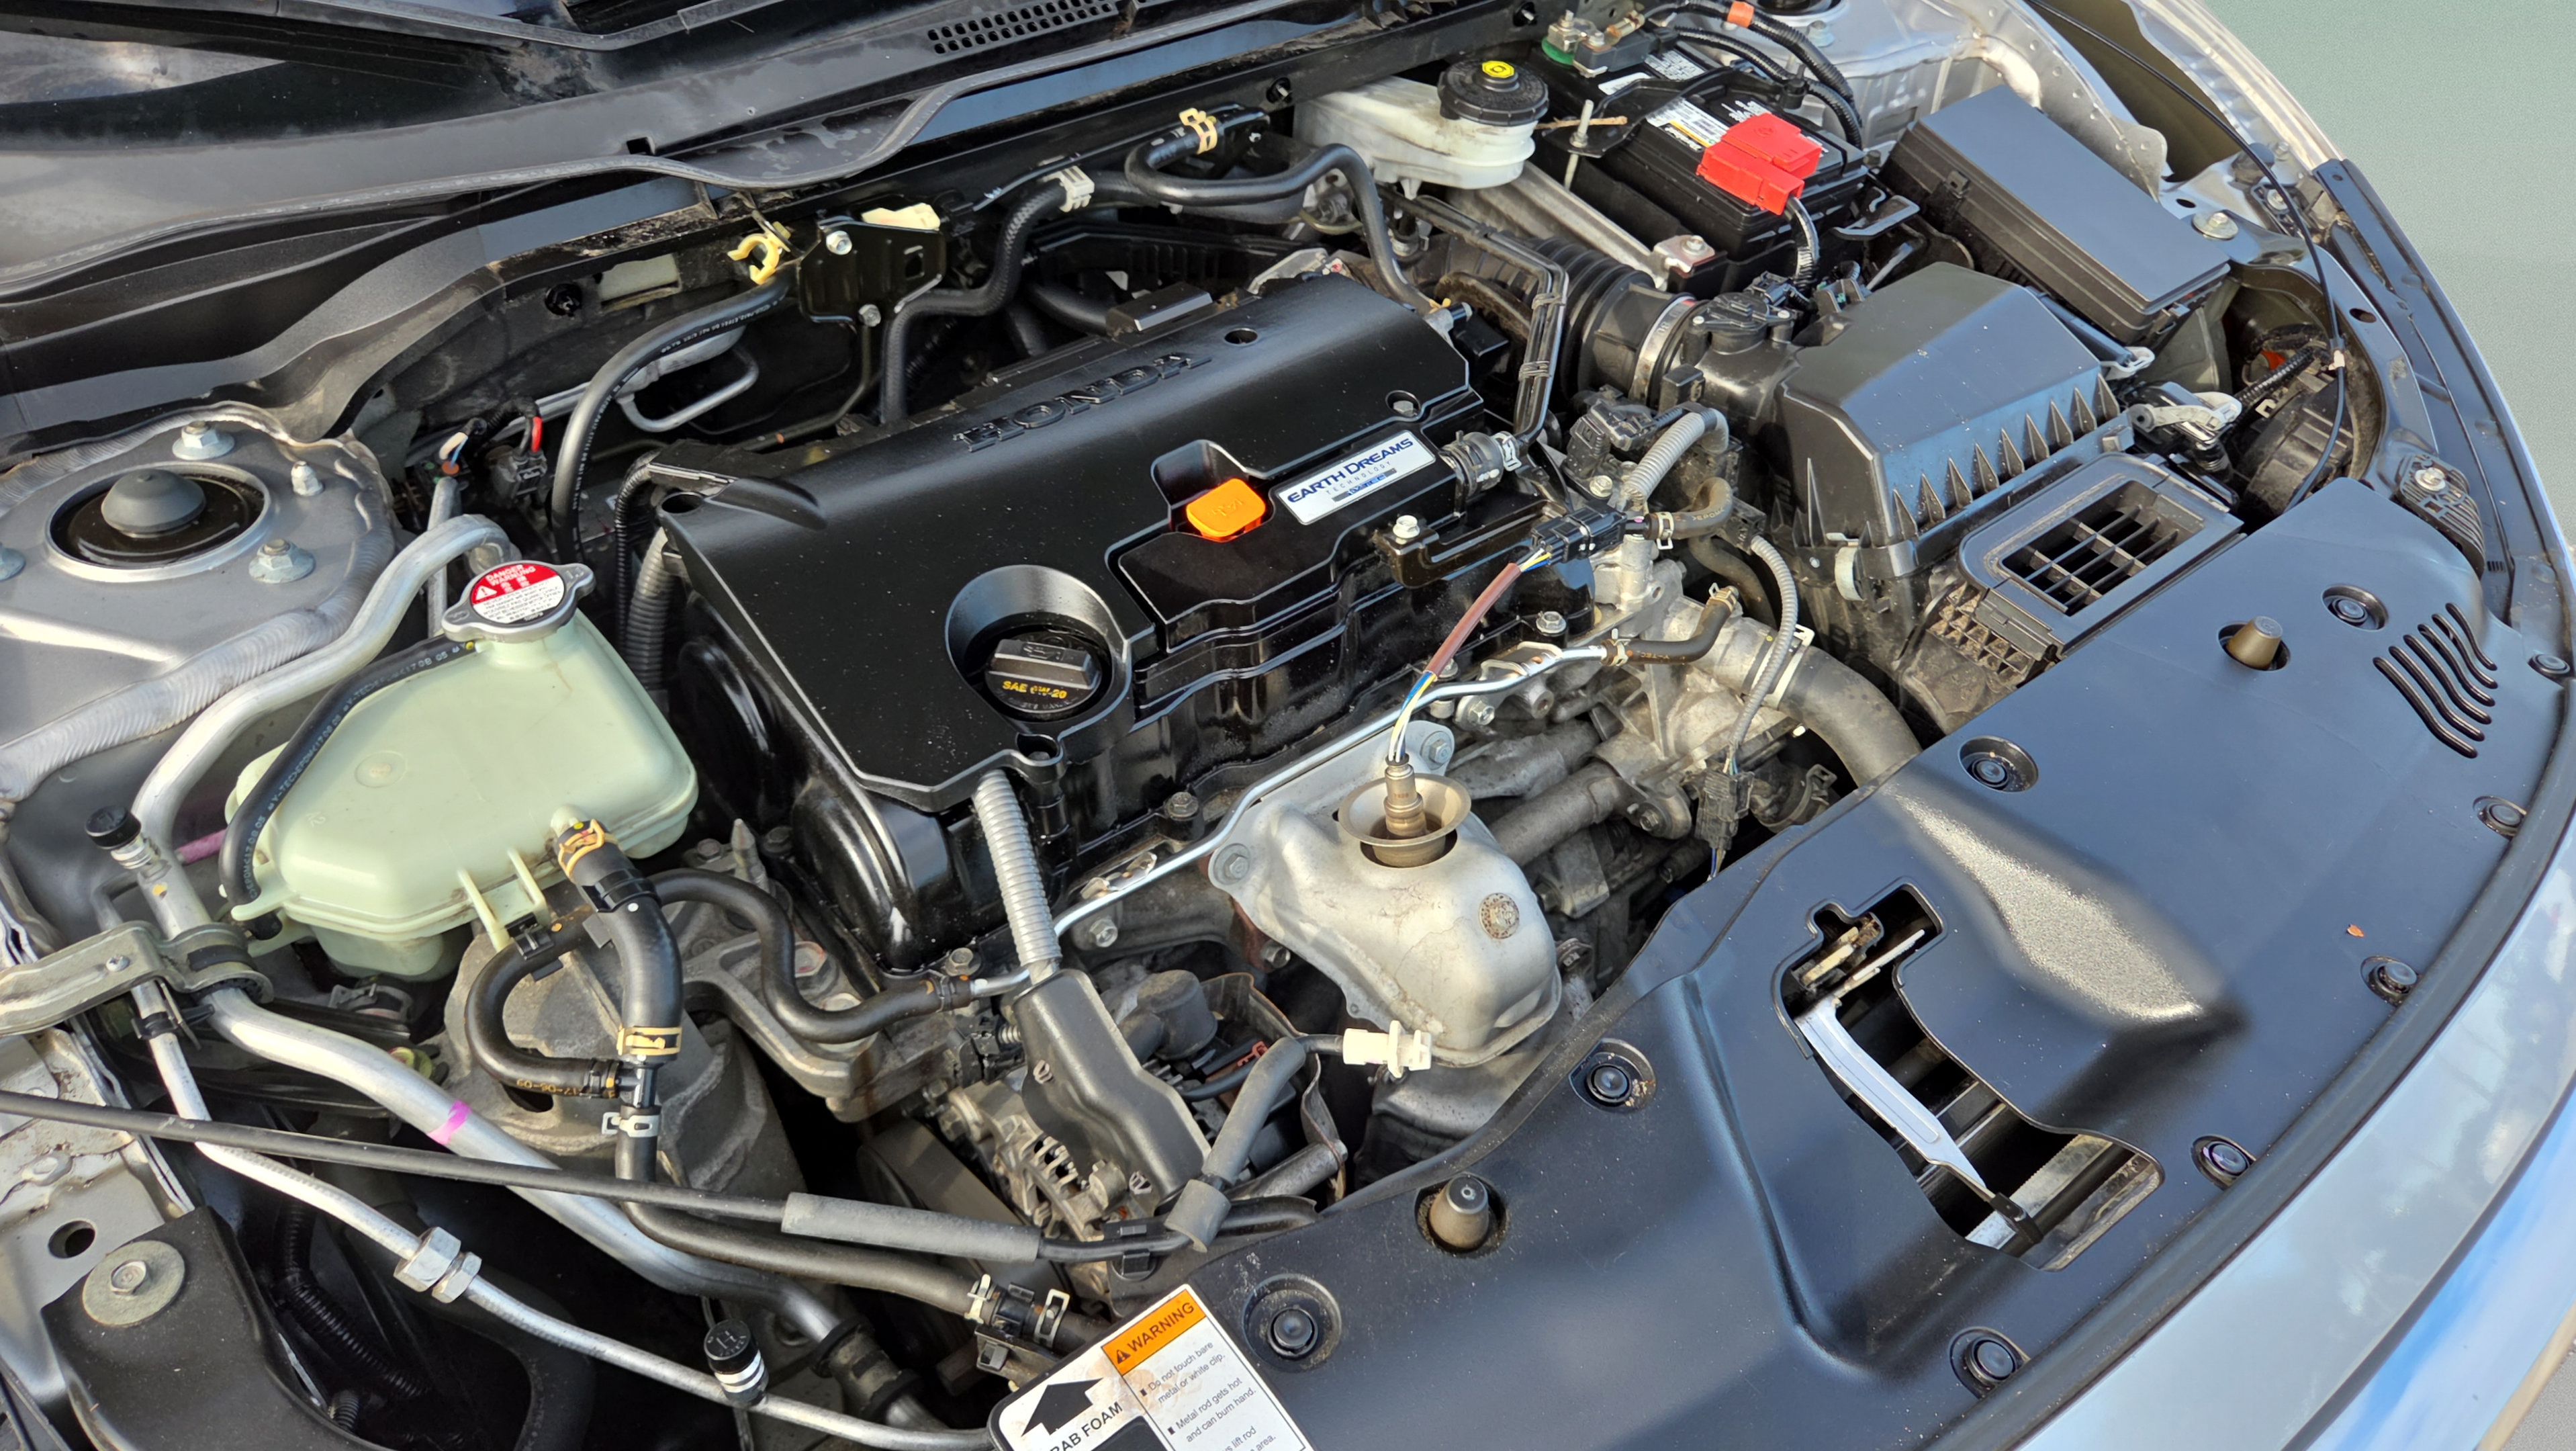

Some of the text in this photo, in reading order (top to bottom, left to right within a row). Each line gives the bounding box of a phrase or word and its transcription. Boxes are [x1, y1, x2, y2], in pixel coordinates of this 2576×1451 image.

[953, 352, 1212, 452] HONDA
[1287, 438, 1414, 503] EARTH DREAMS
[1326, 461, 1391, 495] TECHNOLOGY
[486, 564, 524, 582] DANGER
[490, 566, 536, 586] WARNUNG
[1002, 680, 1027, 693] SAE
[1127, 1301, 1195, 1353] WARNING
[1148, 1343, 1213, 1391] Do not touch bare
[1158, 1354, 1225, 1403] metal or white clip.
[1081, 1401, 1123, 1437] FOAM
[1176, 1378, 1242, 1429] Metal rod gets hot
[1187, 1387, 1256, 1442] and can burn hand.
[1232, 1425, 1256, 1448] lift rod
[1256, 1435, 1276, 1451] area.
